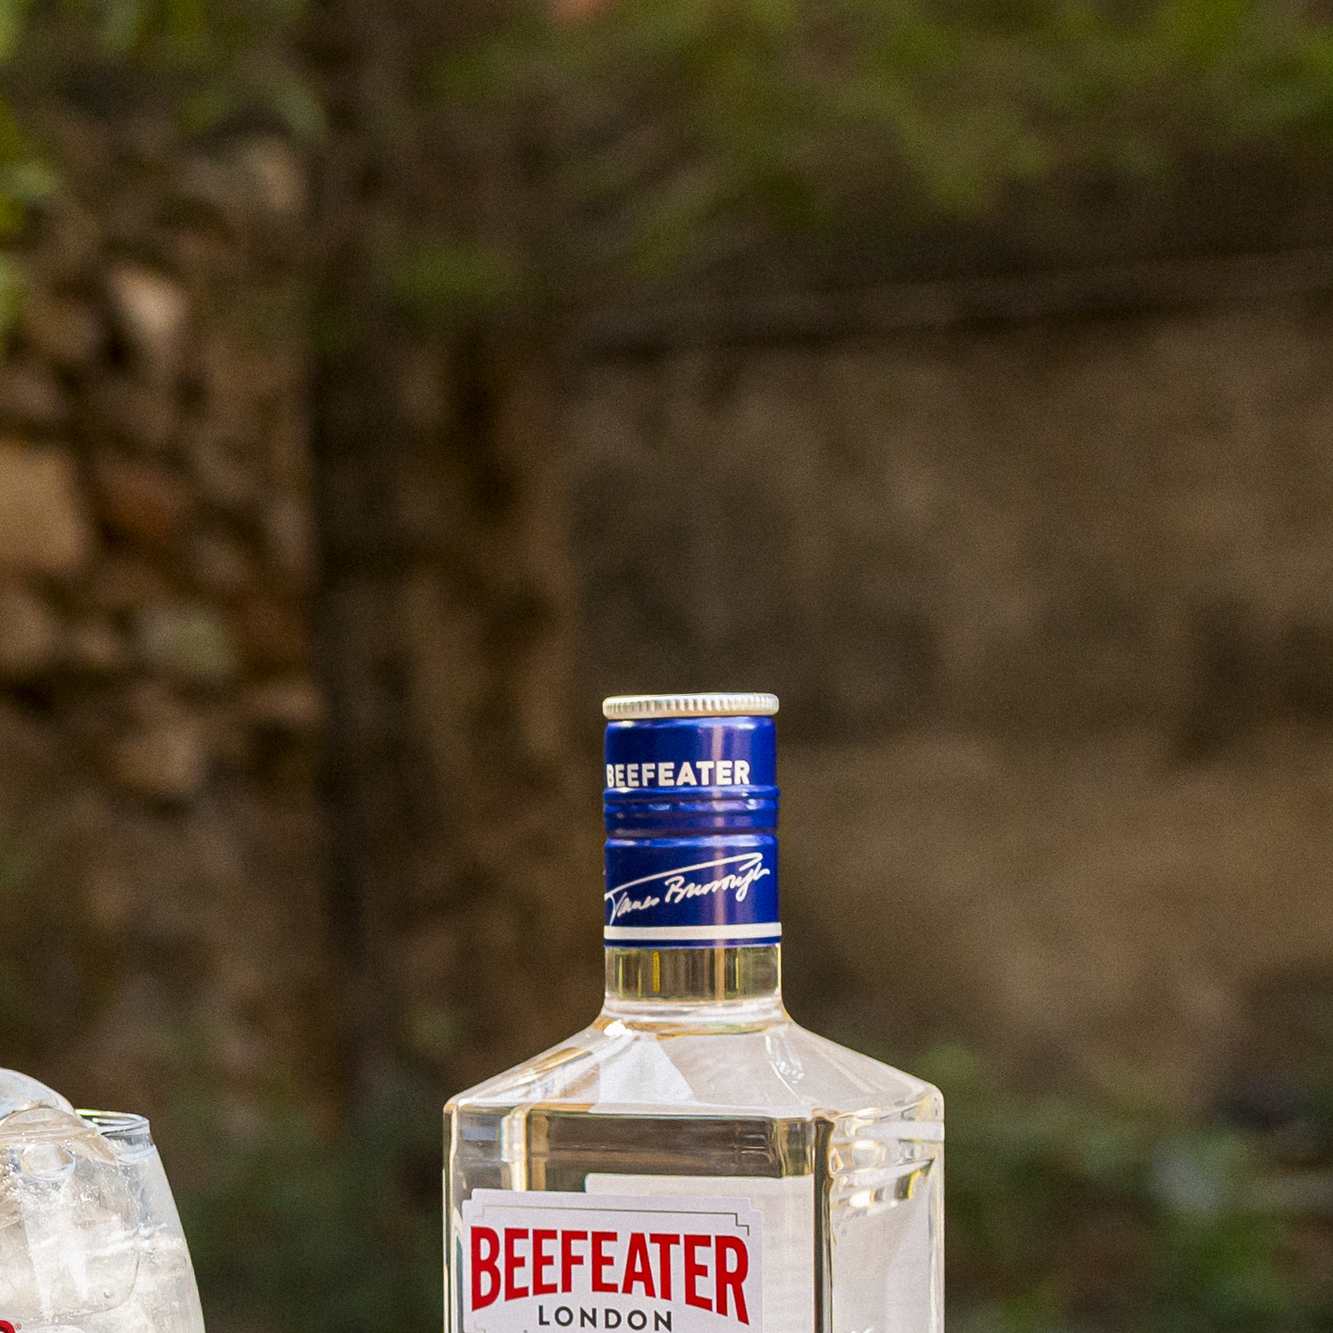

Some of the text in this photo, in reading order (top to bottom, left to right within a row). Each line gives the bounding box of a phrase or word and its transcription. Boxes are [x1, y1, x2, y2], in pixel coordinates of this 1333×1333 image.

[606, 760, 751, 787] BEEFEATER
[470, 1225, 750, 1326] BEEFEATER
[538, 1304, 673, 1333] LONDON
